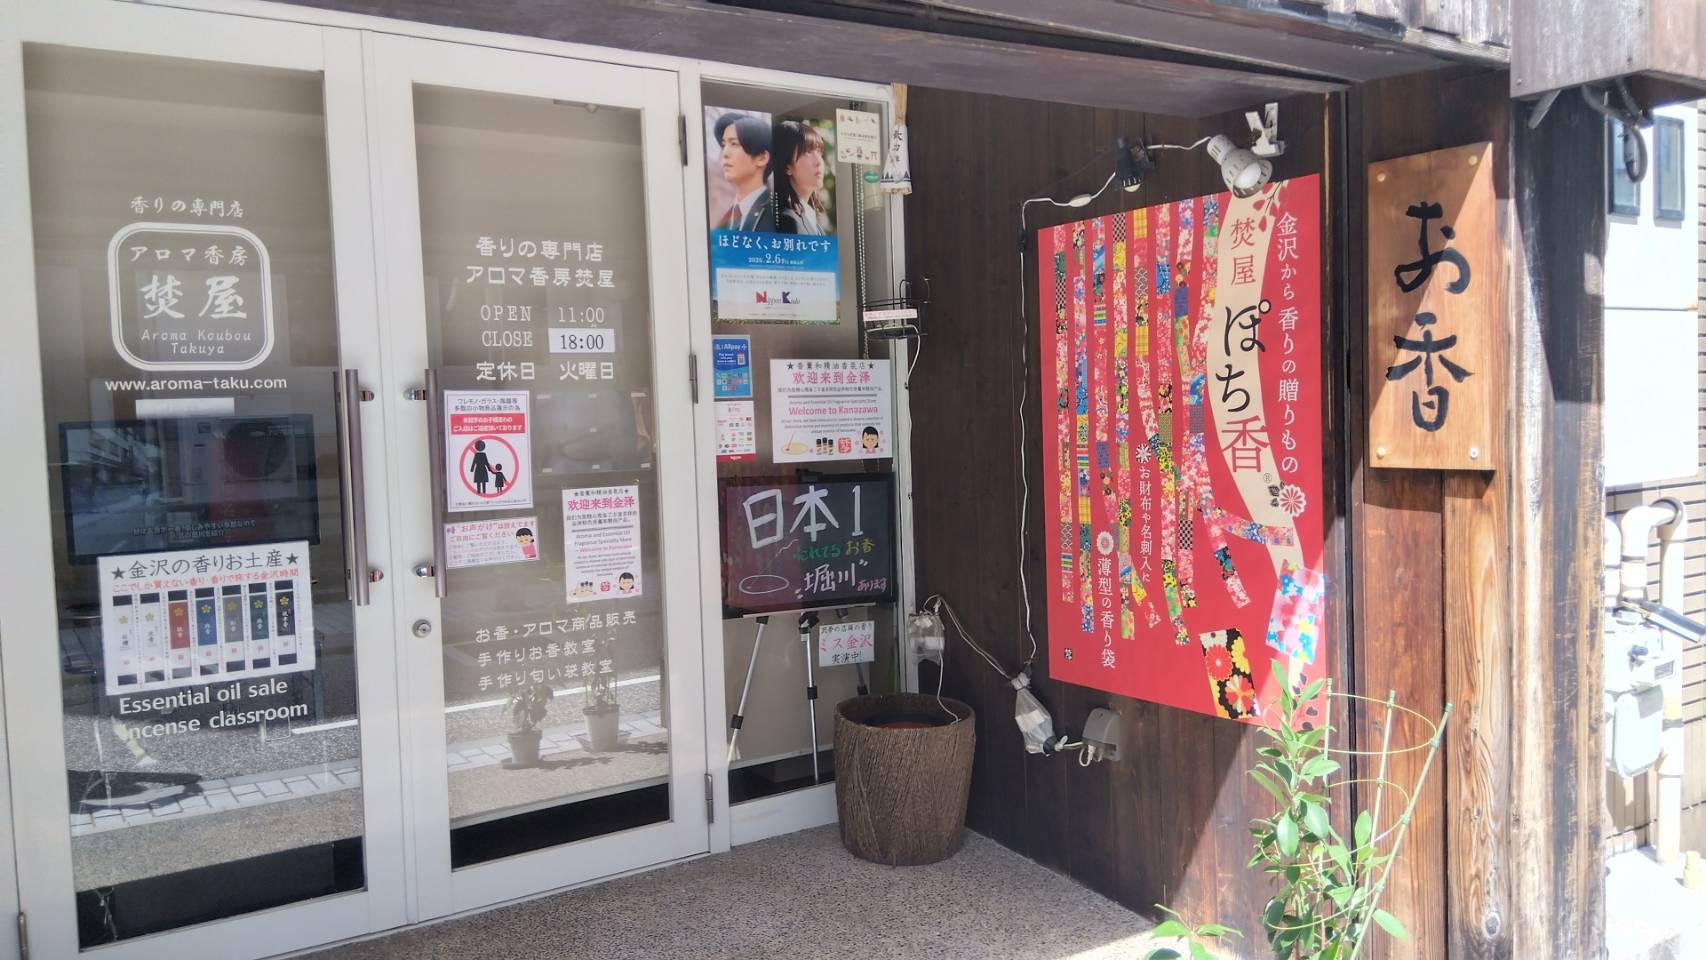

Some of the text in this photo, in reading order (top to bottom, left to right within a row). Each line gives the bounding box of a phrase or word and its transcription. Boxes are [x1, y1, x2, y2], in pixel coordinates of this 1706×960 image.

[130, 196, 244, 218] 香りの専門店
[130, 244, 248, 266] アロマ香房
[476, 236, 603, 262] 香りの専門店
[718, 235, 832, 253] ほどなく、お別れです
[466, 265, 615, 288] アロマ香房焚屋
[140, 274, 247, 319] 焚屋
[481, 305, 605, 323] OPEN 11:00
[1386, 201, 1474, 432] お香
[141, 329, 251, 341] Aroma Koubou
[482, 331, 604, 350] CLOSE 18:00
[1215, 218, 1271, 473] 焚屋 ぽち香
[1277, 212, 1299, 473] 金沢から香りの贈りもの
[171, 342, 225, 355] Takuya
[105, 377, 287, 391] www.aroma-taku.com
[476, 361, 614, 381] 定休日 火曜日
[793, 371, 871, 385] 欢迎来到金泽
[789, 406, 878, 415] Welcome to Kanazawa
[1139, 466, 1152, 583] お財布や名刺入に
[128, 549, 283, 580] 金沢の香りお土産
[1098, 557, 1116, 669] 薄型の香り袋
[475, 610, 637, 643] お香・アロマ商品販売
[478, 639, 596, 667] 手作りお香教室
[478, 659, 613, 691] 手作り匂い袋教室
[119, 678, 288, 715] Essential oil sale
[209, 702, 308, 729] classroom
